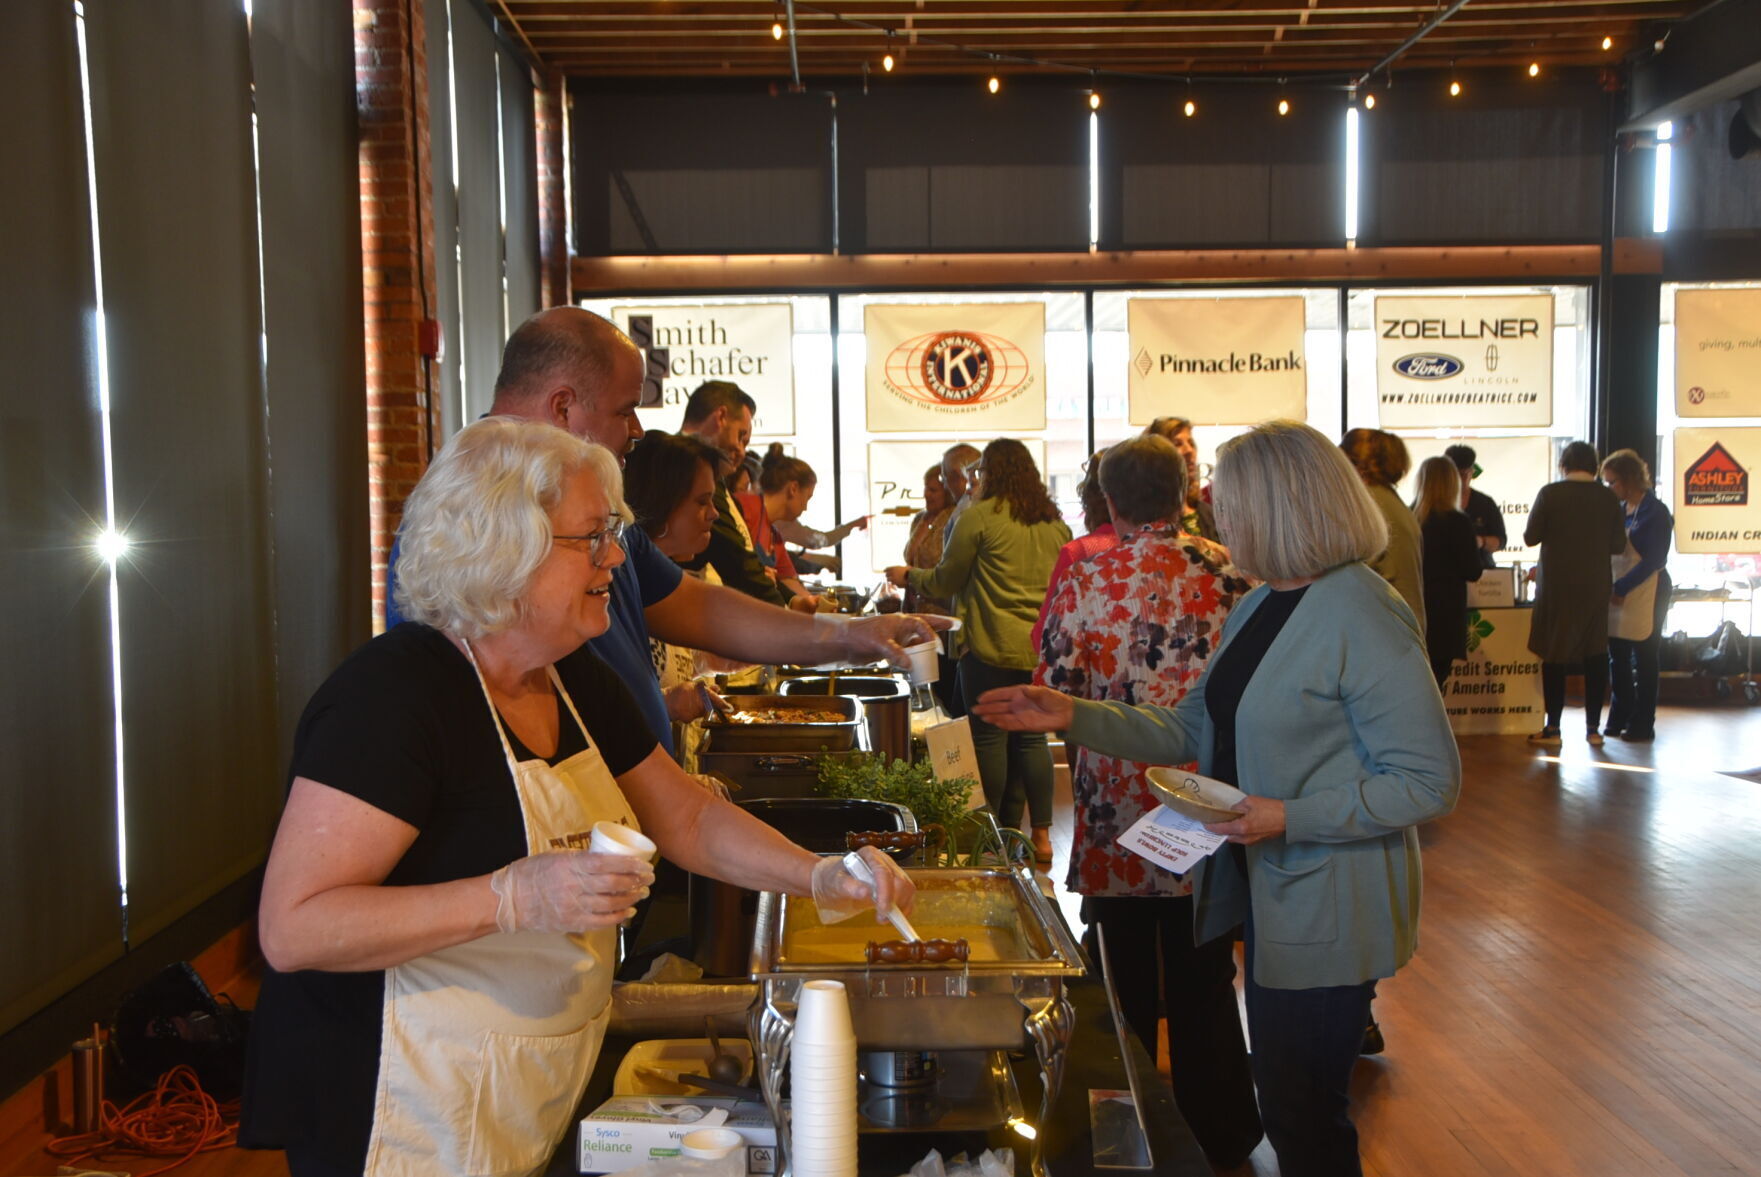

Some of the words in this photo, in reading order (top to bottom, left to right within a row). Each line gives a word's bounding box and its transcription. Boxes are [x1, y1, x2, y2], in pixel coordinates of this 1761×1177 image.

[633, 318, 727, 346] Smith
[1382, 318, 1540, 339] ZOELLNER
[934, 336, 982, 355] KIWANIS
[648, 347, 768, 376] Schafer
[1160, 351, 1246, 373] Pinnacle
[1250, 350, 1302, 372] Bank
[1407, 356, 1448, 376] Ford
[926, 360, 989, 400] INTERNATIONAL
[882, 380, 913, 405] SERVING
[916, 401, 931, 411] THE
[934, 405, 977, 414] CHILDREN
[993, 397, 1008, 408] THE
[1011, 374, 1035, 399] WORLD
[1382, 392, 1538, 404] WWW.ZOELLNEROFBEATRICE.COM
[1689, 472, 1744, 485] ASHLEY
[1499, 500, 1529, 514] ices
[1691, 531, 1738, 540] INDIAN
[1743, 530, 1761, 541] CR
[1448, 661, 1480, 676] redit
[1484, 660, 1539, 676] Services
[1452, 680, 1505, 695] America
[1471, 706, 1505, 714] WORKS
[1508, 705, 1532, 713] HERE
[595, 1128, 621, 1138] Sysco
[583, 1139, 632, 1153] Reliance
